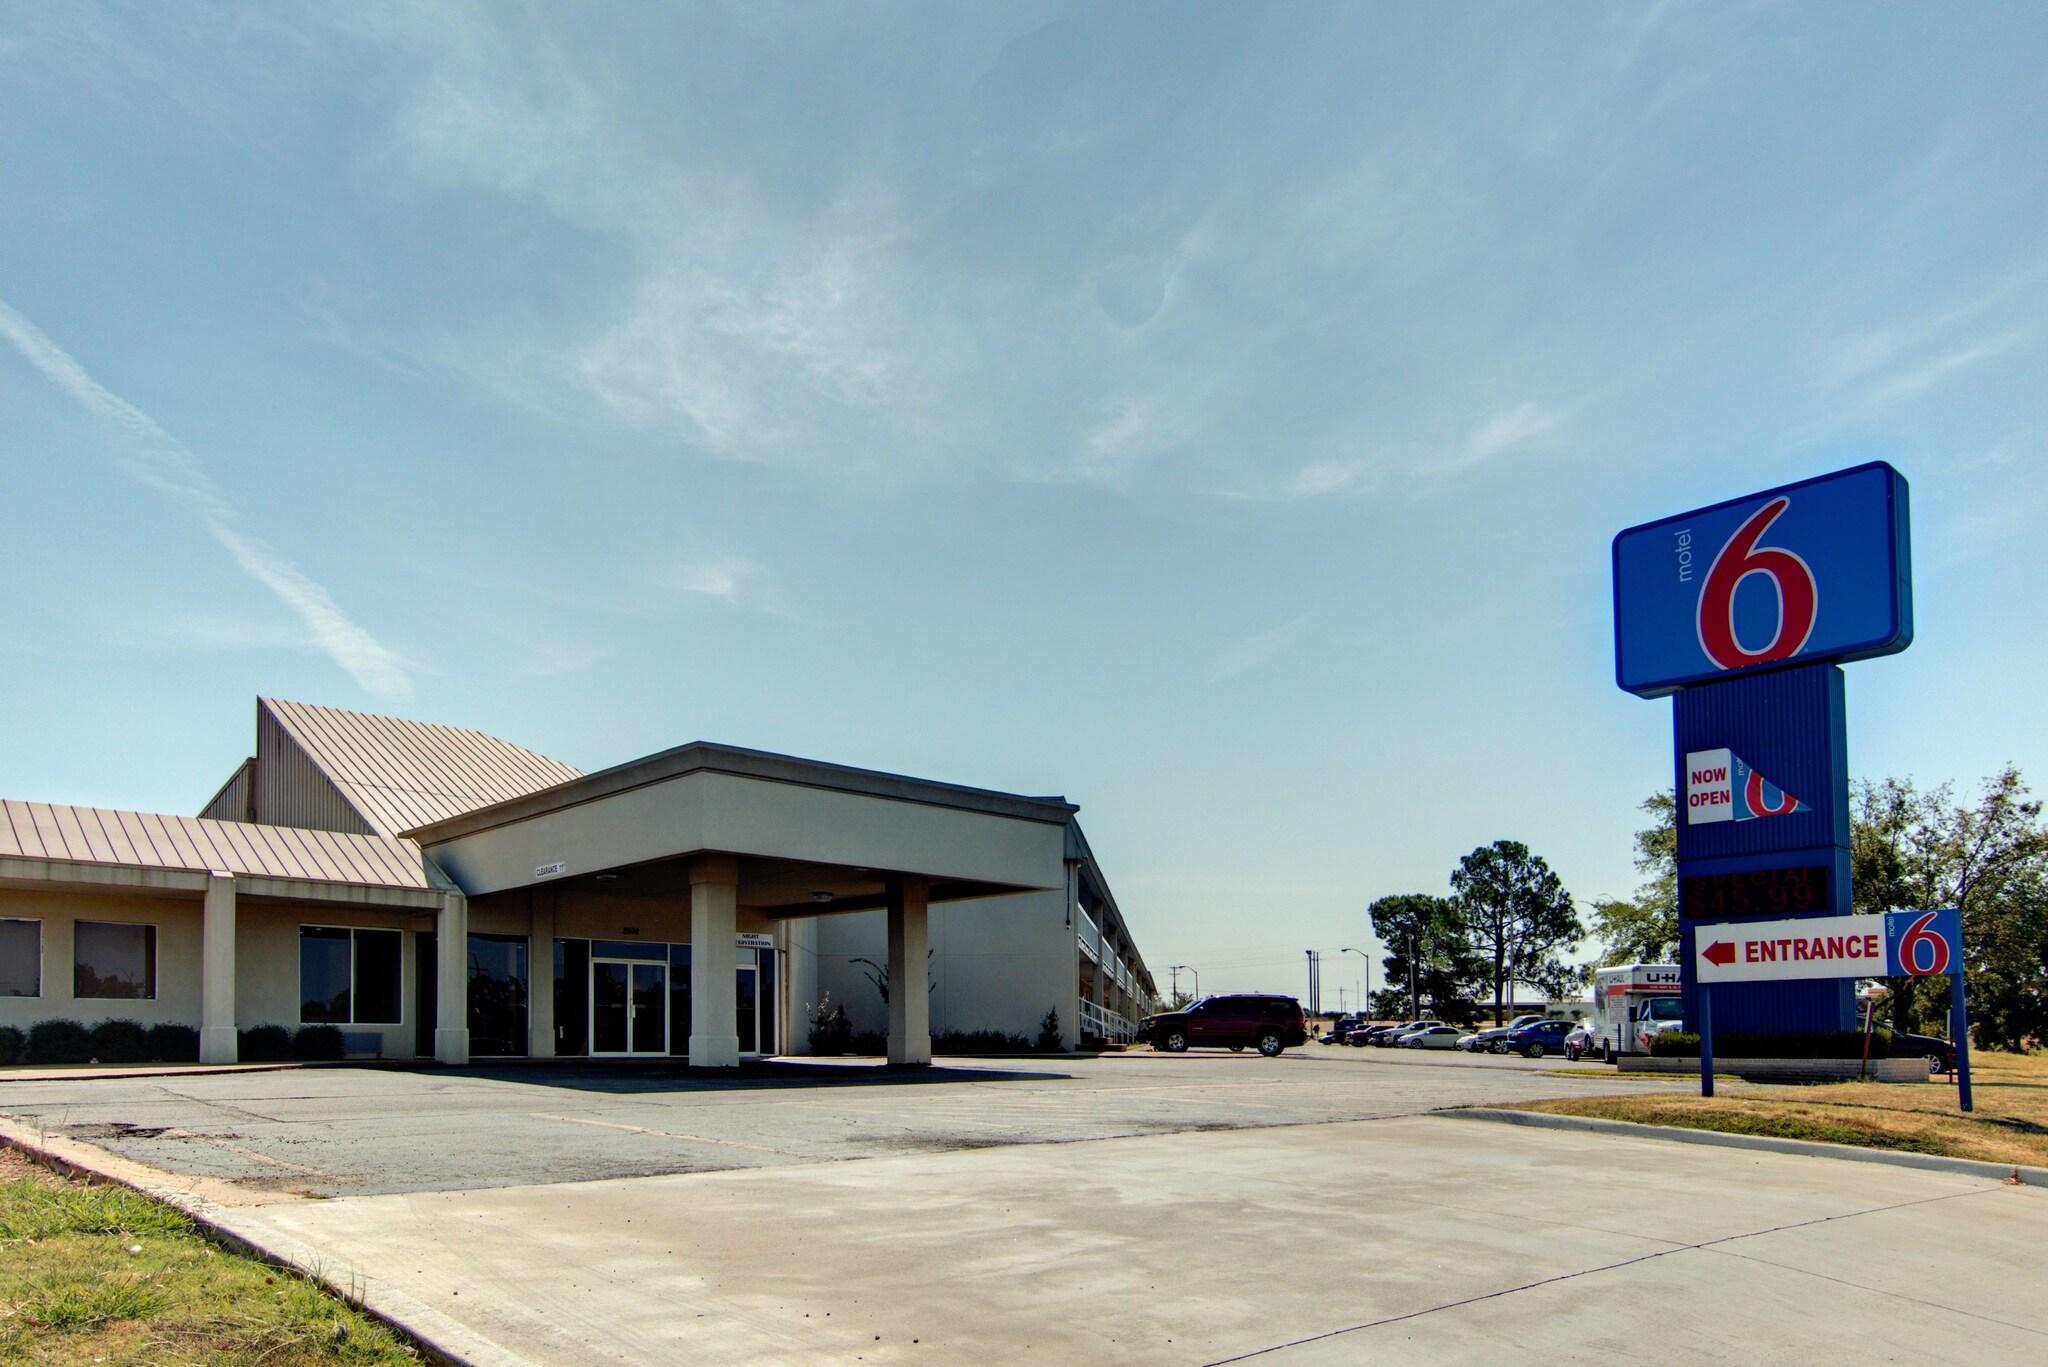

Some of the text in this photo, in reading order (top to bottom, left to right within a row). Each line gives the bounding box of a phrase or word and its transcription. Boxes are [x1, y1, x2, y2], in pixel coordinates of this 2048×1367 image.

[1674, 495, 1818, 670] motel 6
[1691, 767, 1727, 785] NOW
[1689, 789, 1730, 807] OPEN
[1745, 934, 1879, 963] ENTRANCE
[1887, 911, 1950, 976] motel 6
